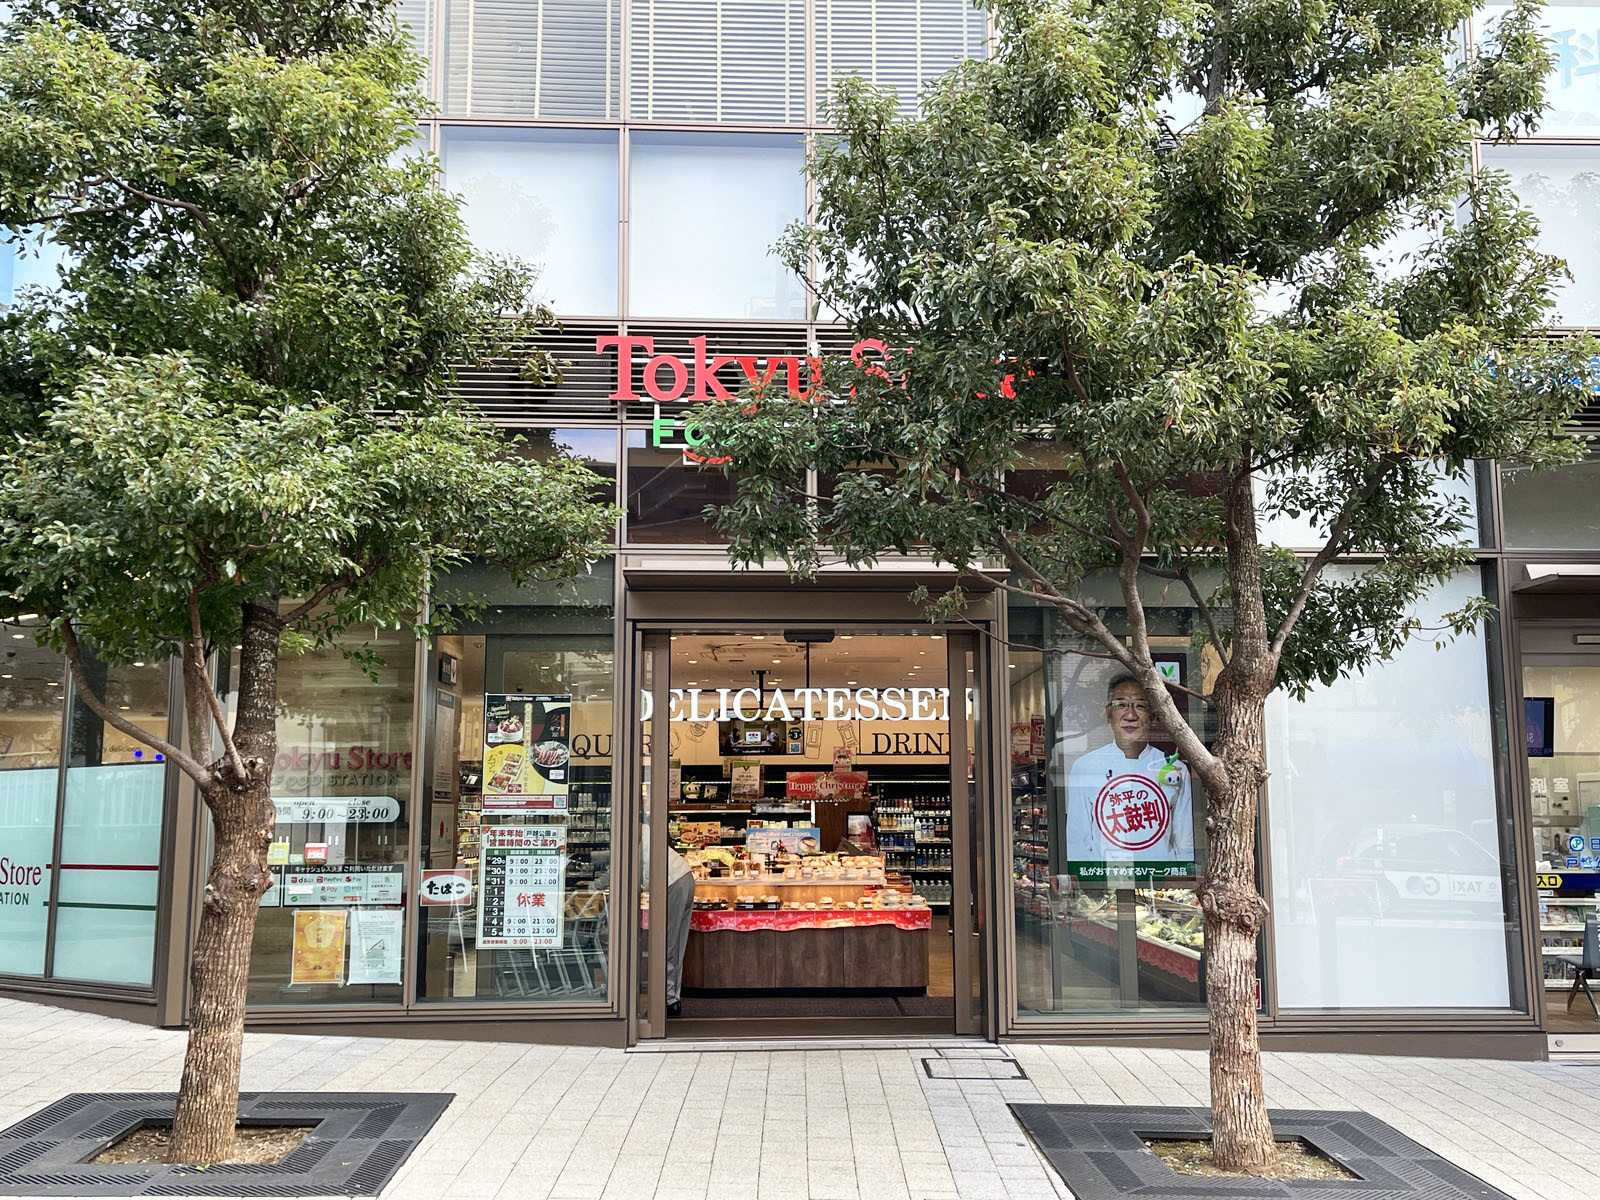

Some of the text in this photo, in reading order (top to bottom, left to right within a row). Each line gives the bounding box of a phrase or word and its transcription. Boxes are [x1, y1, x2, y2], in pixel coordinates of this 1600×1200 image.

[596, 335, 822, 414] Tokyu
[872, 732, 949, 754] DRIN
[330, 774, 399, 786] STATION
[789, 781, 865, 792] Happy Christmas
[1109, 790, 1148, 807] 弥平の
[1106, 799, 1163, 836] 太鼓判
[489, 829, 523, 837] 年末年始
[0, 857, 41, 886] Store
[1079, 867, 1187, 876] 私がおすすめするVマーク商品
[427, 881, 465, 895] たばこ
[1536, 875, 1558, 887] 入口
[517, 893, 546, 907] 休業
